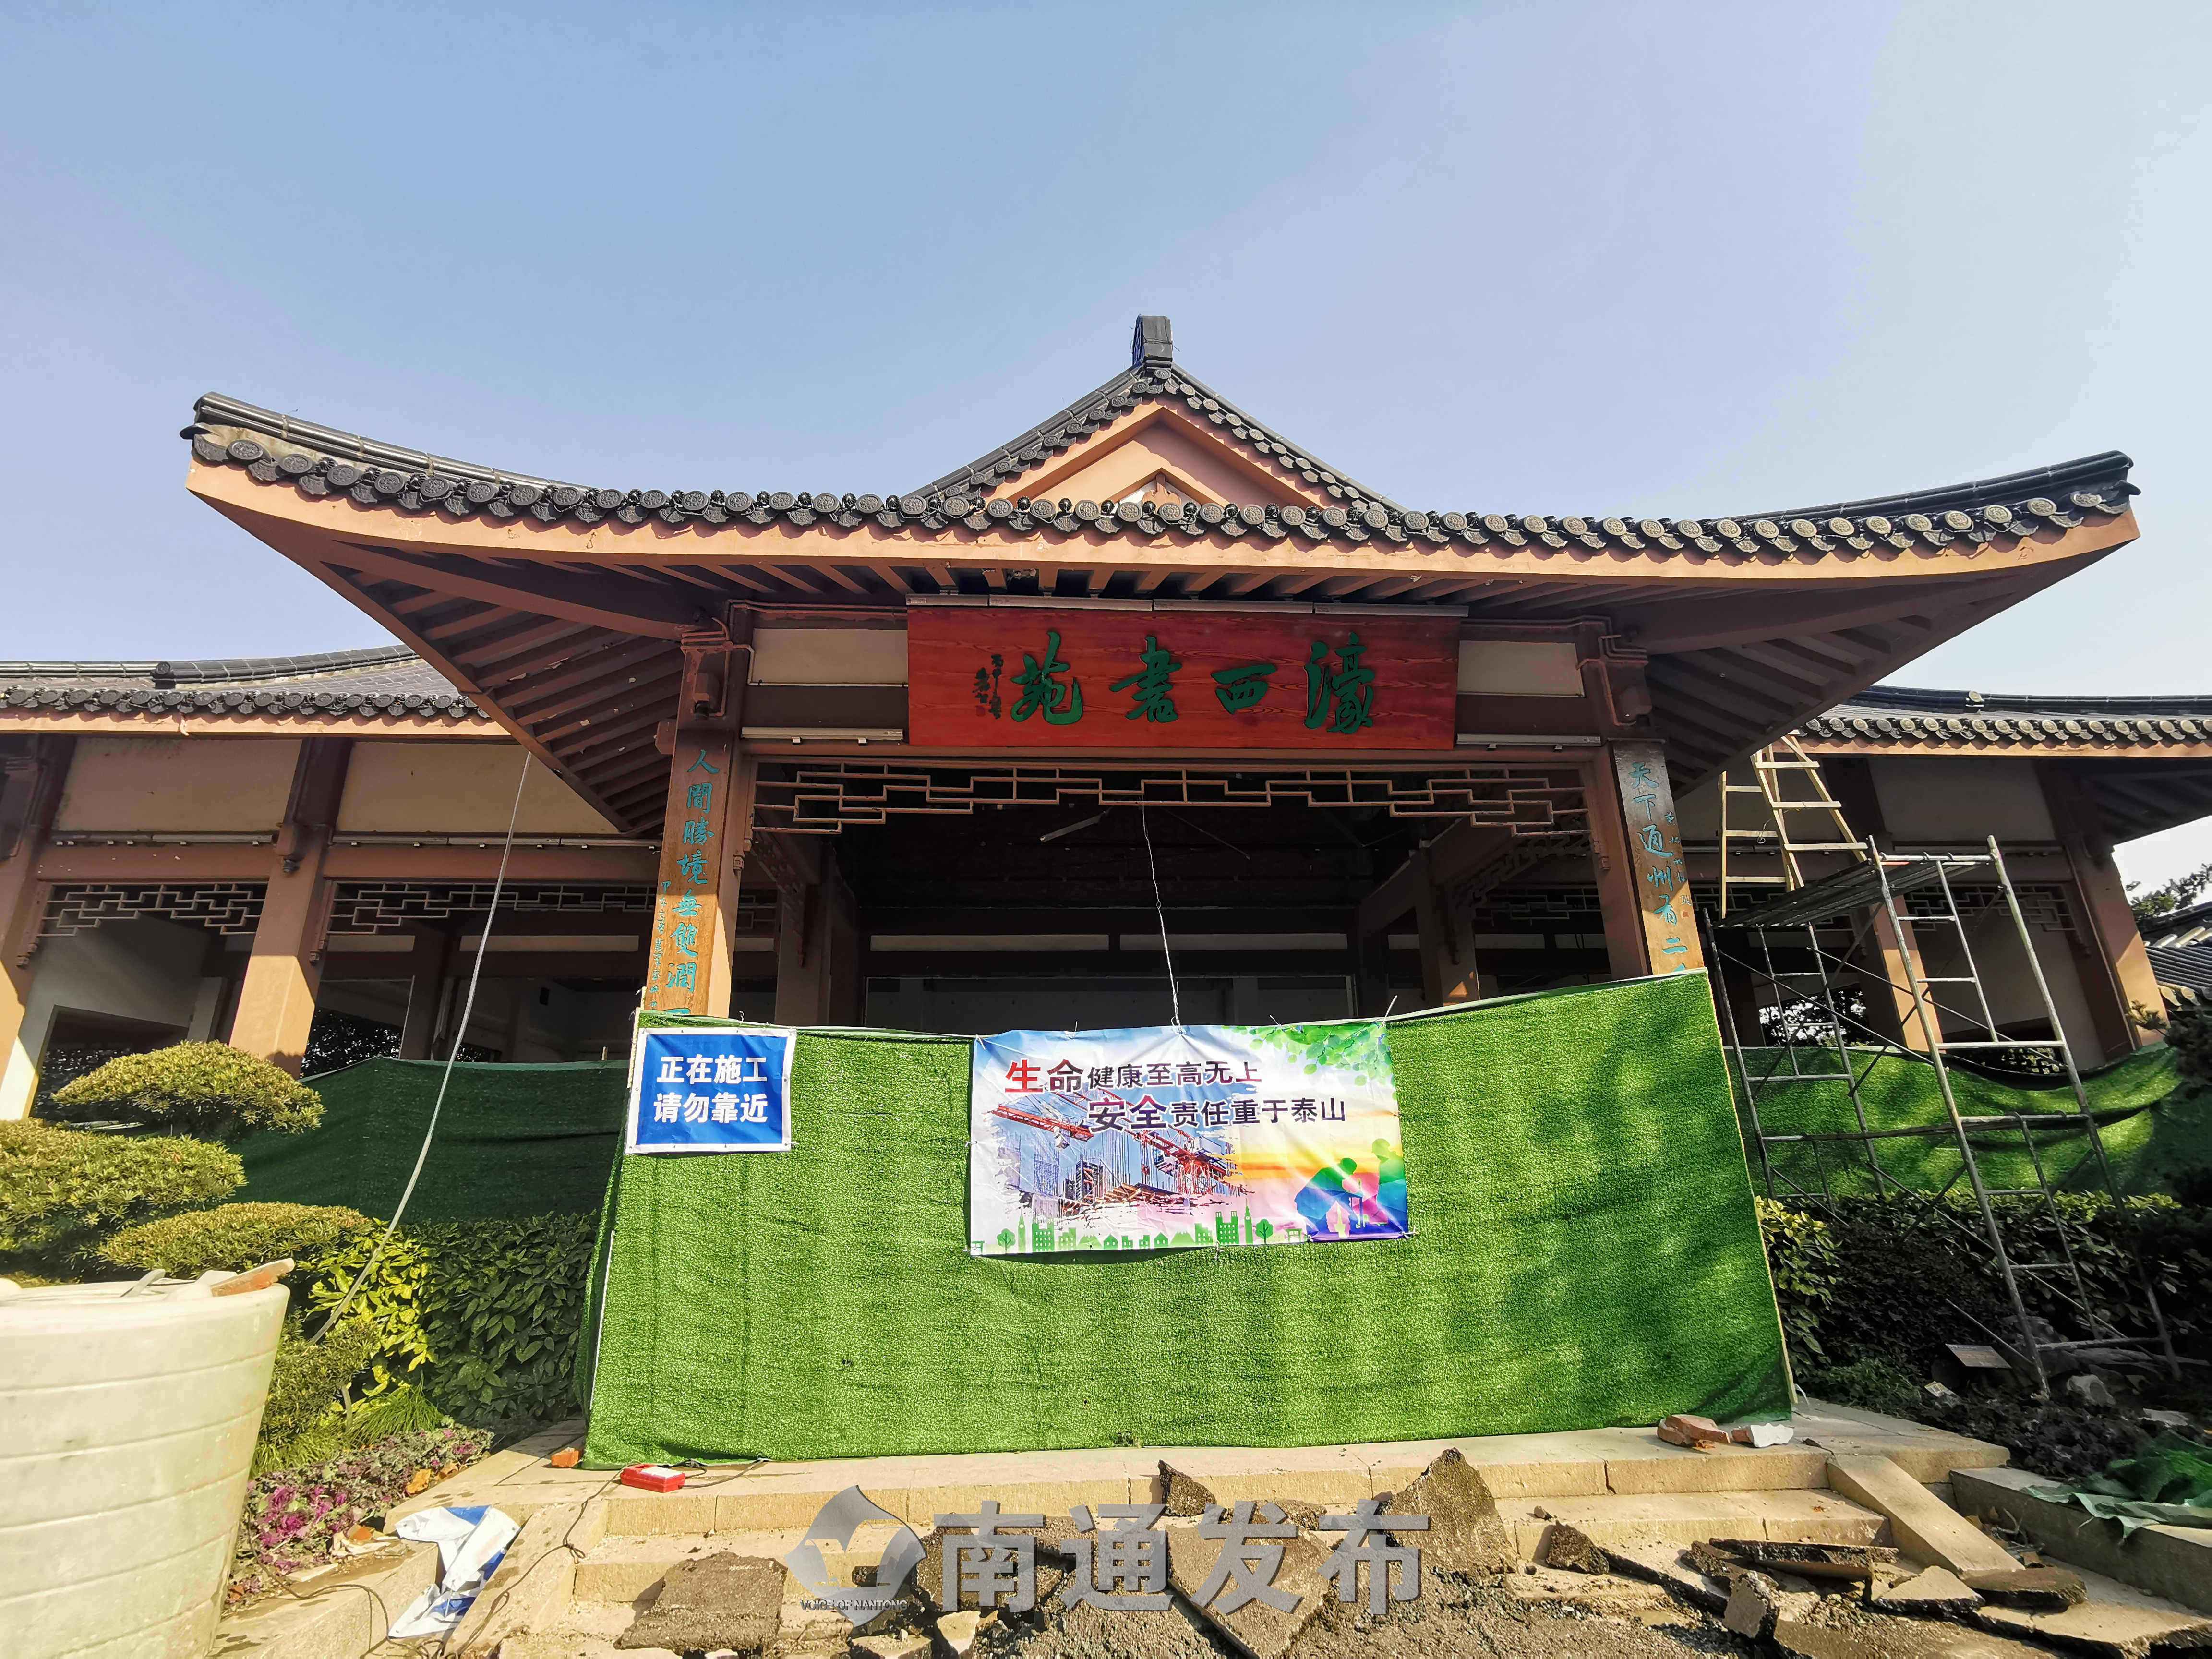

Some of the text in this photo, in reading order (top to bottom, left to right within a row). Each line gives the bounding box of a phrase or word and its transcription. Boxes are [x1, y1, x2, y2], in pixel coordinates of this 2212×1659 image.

[1629, 762, 1688, 972] 天下通州有二
[656, 1054, 767, 1084] 正在施工
[1004, 1059, 1262, 1094] 生命健康至高无上
[653, 1092, 768, 1123] 请勿靠近
[1088, 1094, 1346, 1133] 安全责任重于泰山
